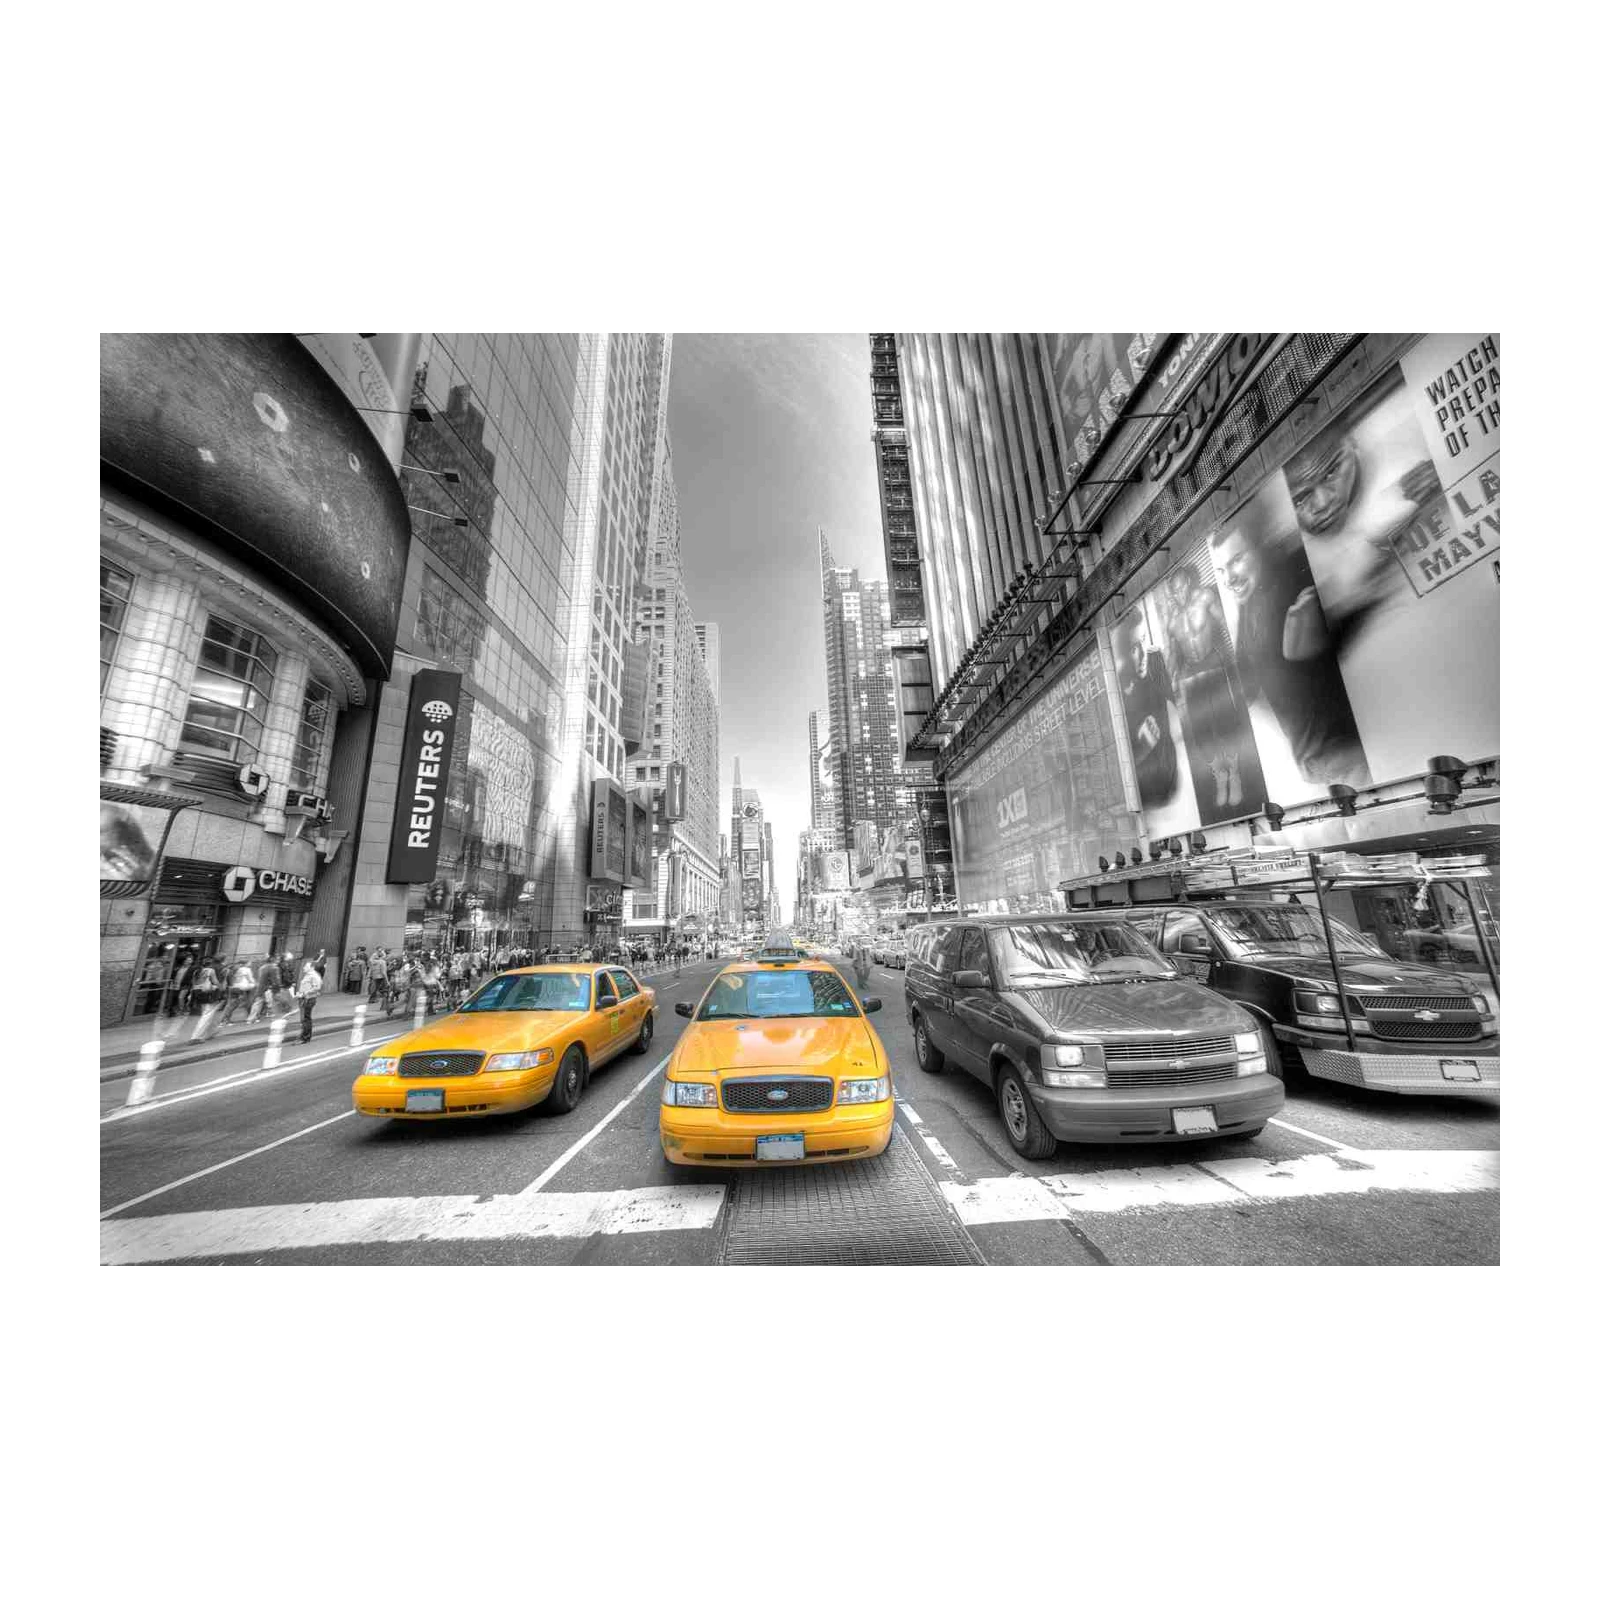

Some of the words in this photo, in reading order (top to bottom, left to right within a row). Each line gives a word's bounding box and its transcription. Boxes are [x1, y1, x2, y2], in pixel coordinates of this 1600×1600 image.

[1424, 335, 1498, 407] WATCH
[1445, 423, 1469, 458] OF
[1407, 508, 1452, 553] DE
[1049, 649, 1101, 708] UNIVERSE
[1068, 676, 1106, 716] LEVEL
[407, 729, 445, 849] REUTERS
[259, 870, 313, 896] CHASE
